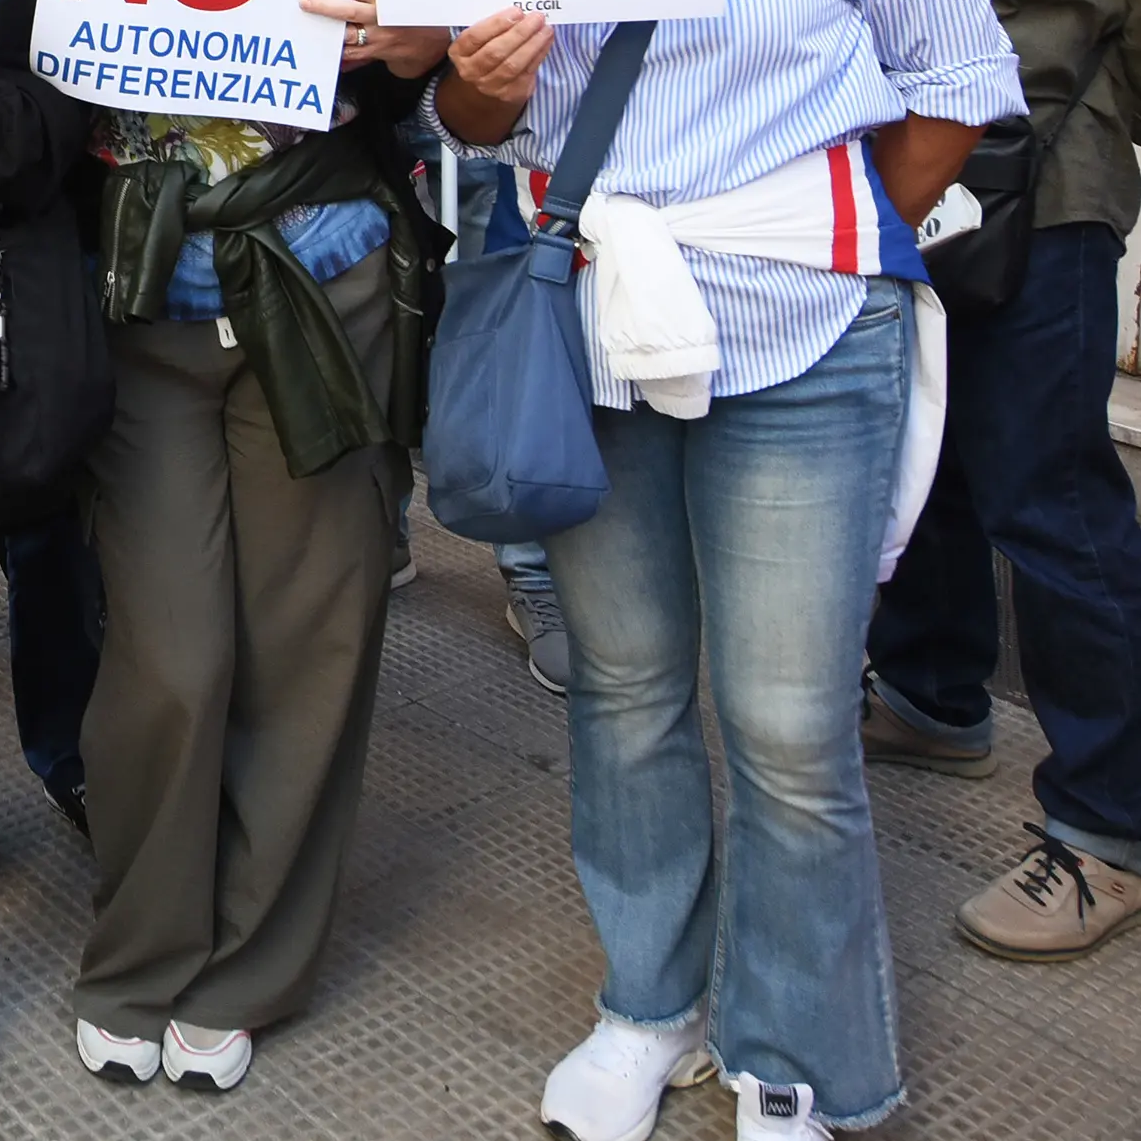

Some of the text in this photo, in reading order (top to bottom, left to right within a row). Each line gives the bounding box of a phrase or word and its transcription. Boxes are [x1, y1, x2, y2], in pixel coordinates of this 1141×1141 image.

[536, 0, 562, 10] CGIL
[69, 21, 298, 70] AUTONOMIA
[36, 50, 324, 115] DIFFERENZIATA
